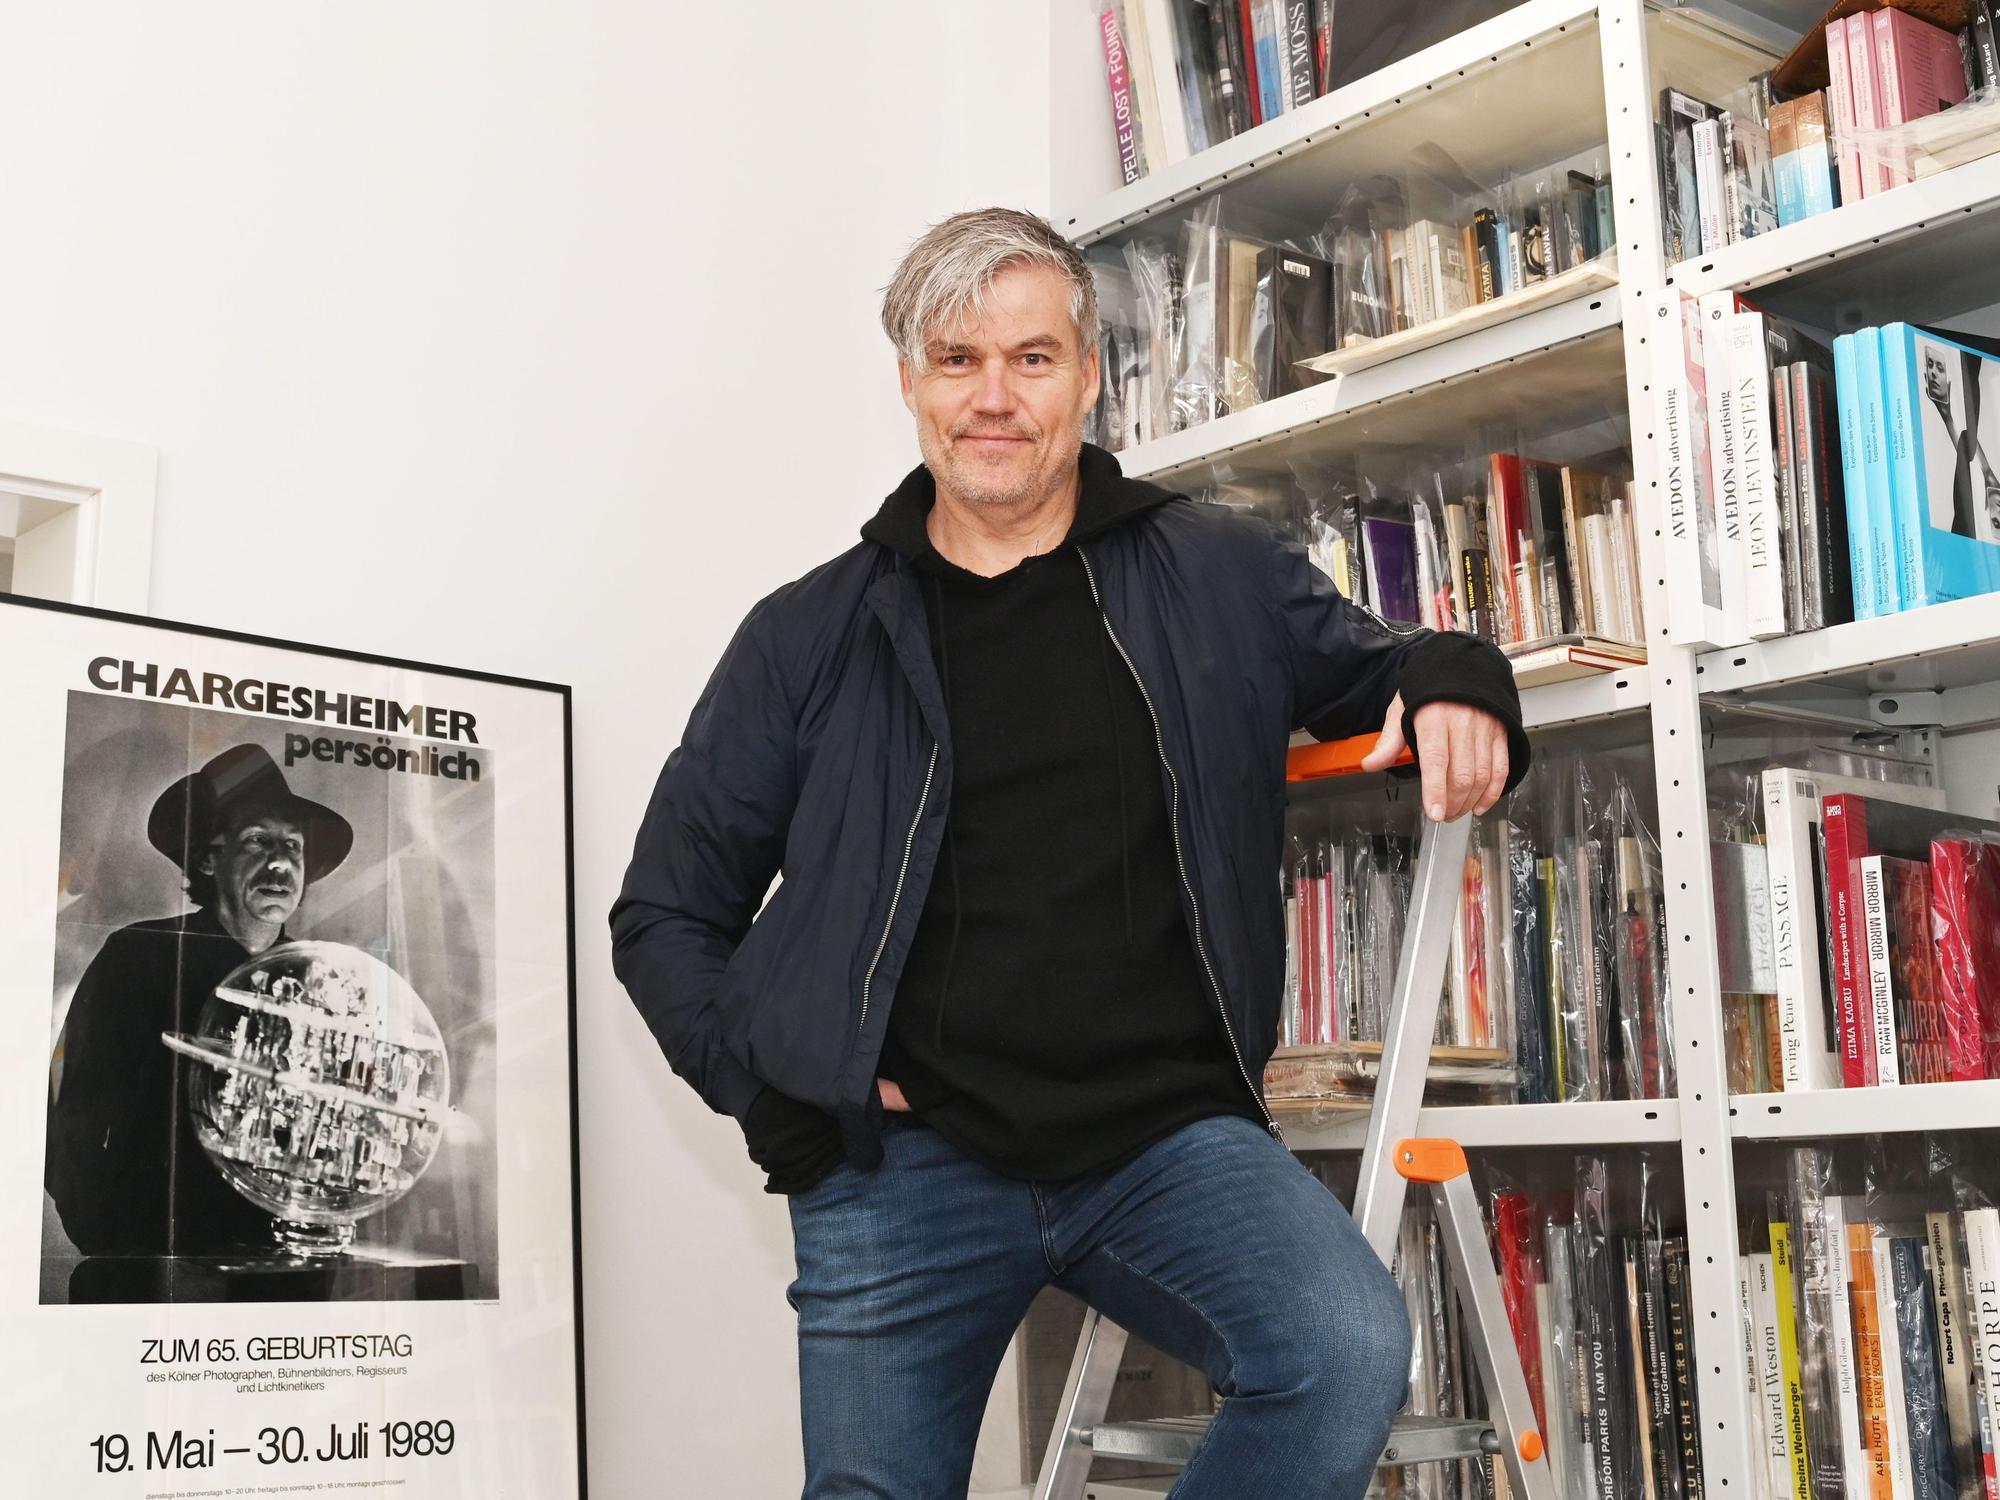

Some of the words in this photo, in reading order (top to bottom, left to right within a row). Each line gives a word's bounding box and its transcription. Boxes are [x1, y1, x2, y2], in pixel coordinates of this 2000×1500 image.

[1102, 14, 1123, 75] FOUND!
[1289, 1, 1308, 67] MOSS
[1982, 43, 1994, 75] Rickard
[1113, 89, 1131, 127] LOST
[1294, 70, 1311, 109] TE
[1119, 130, 1137, 183] PELLE
[1543, 227, 1551, 265] RAVAL
[1666, 387, 1680, 462] advertising
[1720, 391, 1734, 464] advertising
[1740, 377, 1763, 504] LEVINSTEIN
[1800, 464, 1808, 491] Evans
[1669, 466, 1685, 539] AVEDON
[1723, 468, 1740, 540] AVEDON
[1802, 493, 1811, 525] Walker
[1749, 512, 1766, 568] LEON
[87, 656, 479, 744] CHARGESHEIMER
[284, 733, 481, 782] persönlich
[1837, 892, 1846, 915] Corpse
[1866, 871, 1879, 913] MIRROR
[1774, 876, 1793, 968] PASSAGE
[1869, 917, 1884, 960] MIRROR
[1841, 939, 1850, 980] Landscapes
[1576, 964, 1584, 1001] HUGO
[1873, 970, 1887, 1025] MCGINLEY
[1783, 998, 1795, 1033] Penn
[1845, 988, 1853, 1023] KAORU
[1899, 1000, 1943, 1041] MIRR
[1579, 1004, 1587, 1049] PIETER
[1849, 1027, 1857, 1058] IZIMA
[1880, 1026, 1892, 1055] RYAN
[1786, 1037, 1801, 1082] Irving
[1899, 1252, 1907, 1283] PRESTEL
[1933, 1222, 1948, 1297] Photographien
[1942, 1302, 1952, 1326] Capa
[140, 1339, 200, 1363] ZUM
[207, 1339, 240, 1362] 65.
[247, 1334, 413, 1360] GEBURTSTAG
[1593, 1342, 1603, 1368] YOU
[1671, 1302, 1686, 1385] ARBEIT
[1766, 1326, 1779, 1387] Weston
[1840, 1337, 1848, 1367] Gibson
[1871, 1340, 1881, 1376] WORKS
[1944, 1329, 1955, 1365] Robert
[146, 1371, 166, 1383] des
[168, 1370, 202, 1382] Kölner
[204, 1369, 275, 1383] Photographen,
[278, 1367, 354, 1379] Bühnenbildners,
[356, 1366, 407, 1379] Regisseurs
[237, 1382, 255, 1393] und
[258, 1381, 325, 1392] Lichtkinetikers
[1596, 1372, 1605, 1394] AM
[1659, 1351, 1670, 1391] Graham
[1842, 1369, 1852, 1393] Ralph
[1863, 1354, 1873, 1408] FRÜHWERK
[1663, 1392, 1671, 1415] Paul
[1874, 1379, 1885, 1408] EARLY
[1599, 1409, 1609, 1452] PARKS
[1771, 1393, 1786, 1457] Edward
[1790, 1381, 1804, 1454] Weinberger
[90, 1433, 134, 1473] 19.
[146, 1429, 215, 1470] Mai
[257, 1426, 309, 1464] 30.
[316, 1422, 369, 1461] Juli
[379, 1419, 455, 1459] 1989
[1681, 1400, 1698, 1500] EUTSCHE
[1876, 1451, 1884, 1475] AXEL
[1603, 1457, 1614, 1500] ORDON
[1798, 1457, 1809, 1500] rlheinz
[1918, 1453, 1929, 1497] McCURRY
